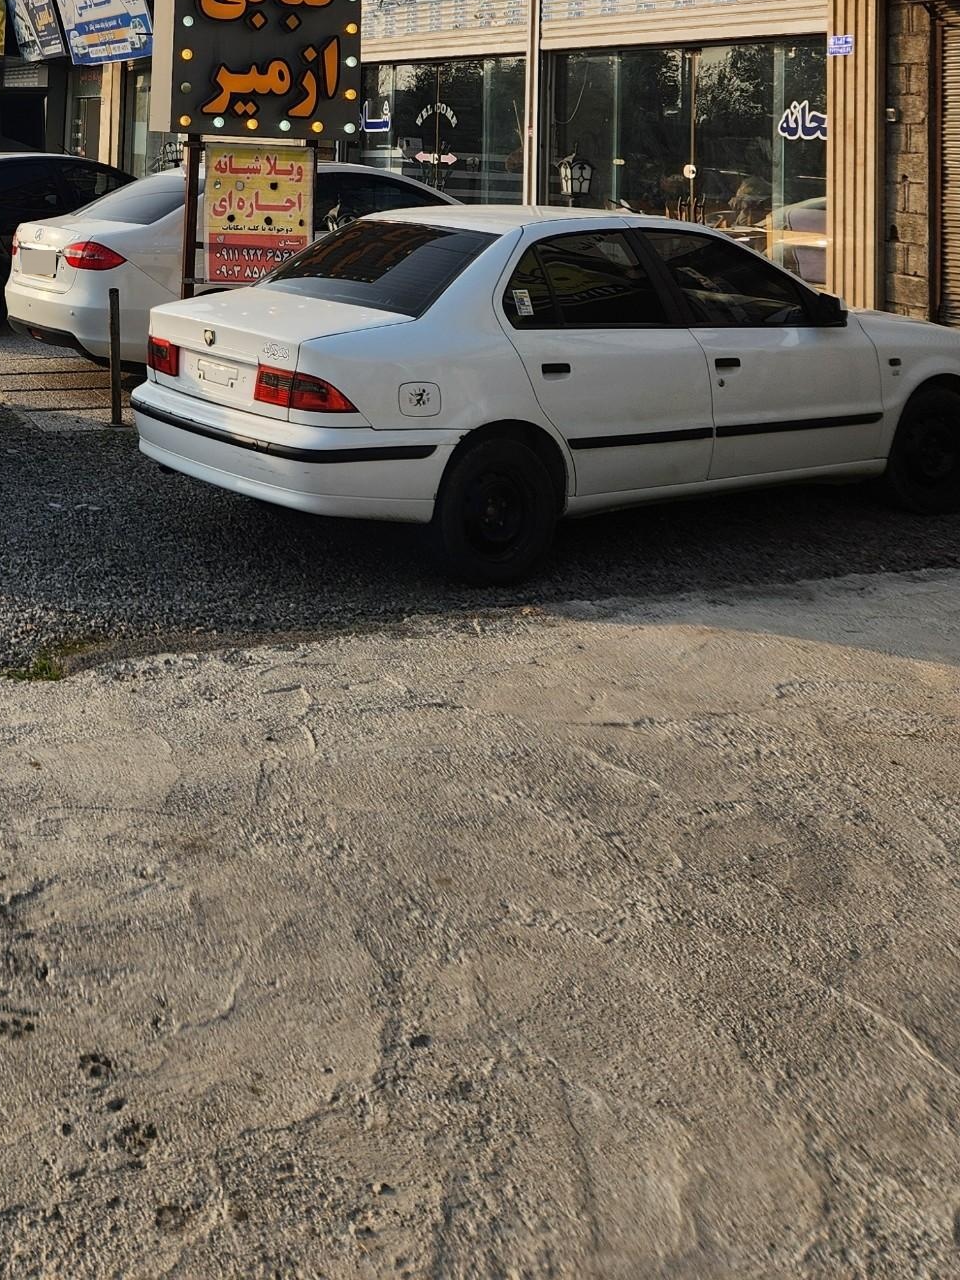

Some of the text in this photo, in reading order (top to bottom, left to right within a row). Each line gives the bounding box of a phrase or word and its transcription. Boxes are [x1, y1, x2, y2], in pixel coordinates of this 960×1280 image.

[201, 36, 340, 118] ازمیر
[214, 154, 304, 183] ویلا شبانه
[212, 189, 302, 218] اجاره ای
[216, 248, 239, 261] ۰۹۱۱
[216, 264, 241, 278] ۰۹۰۳
